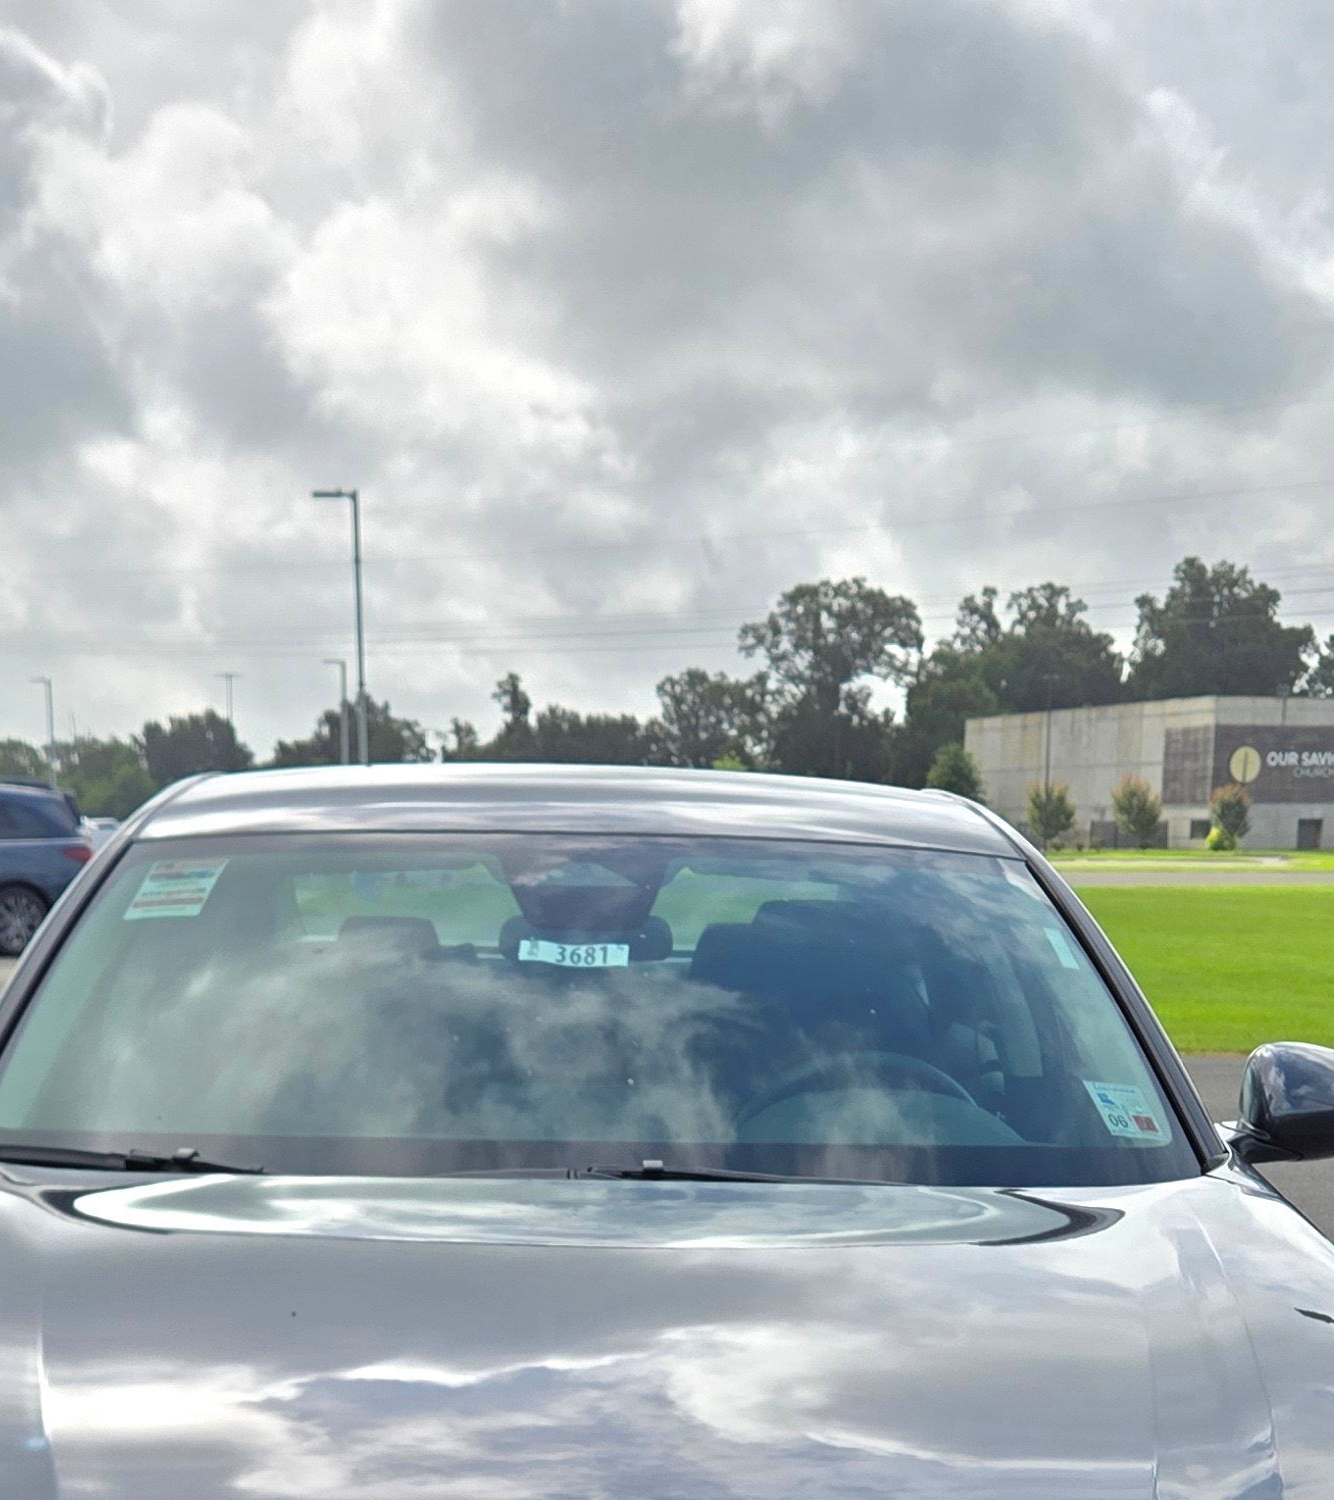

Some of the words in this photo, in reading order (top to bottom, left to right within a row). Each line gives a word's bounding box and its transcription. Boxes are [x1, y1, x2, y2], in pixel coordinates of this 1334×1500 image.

[1266, 750, 1299, 767] OUR
[555, 945, 609, 966] 3681
[1108, 1113, 1129, 1129] 06
